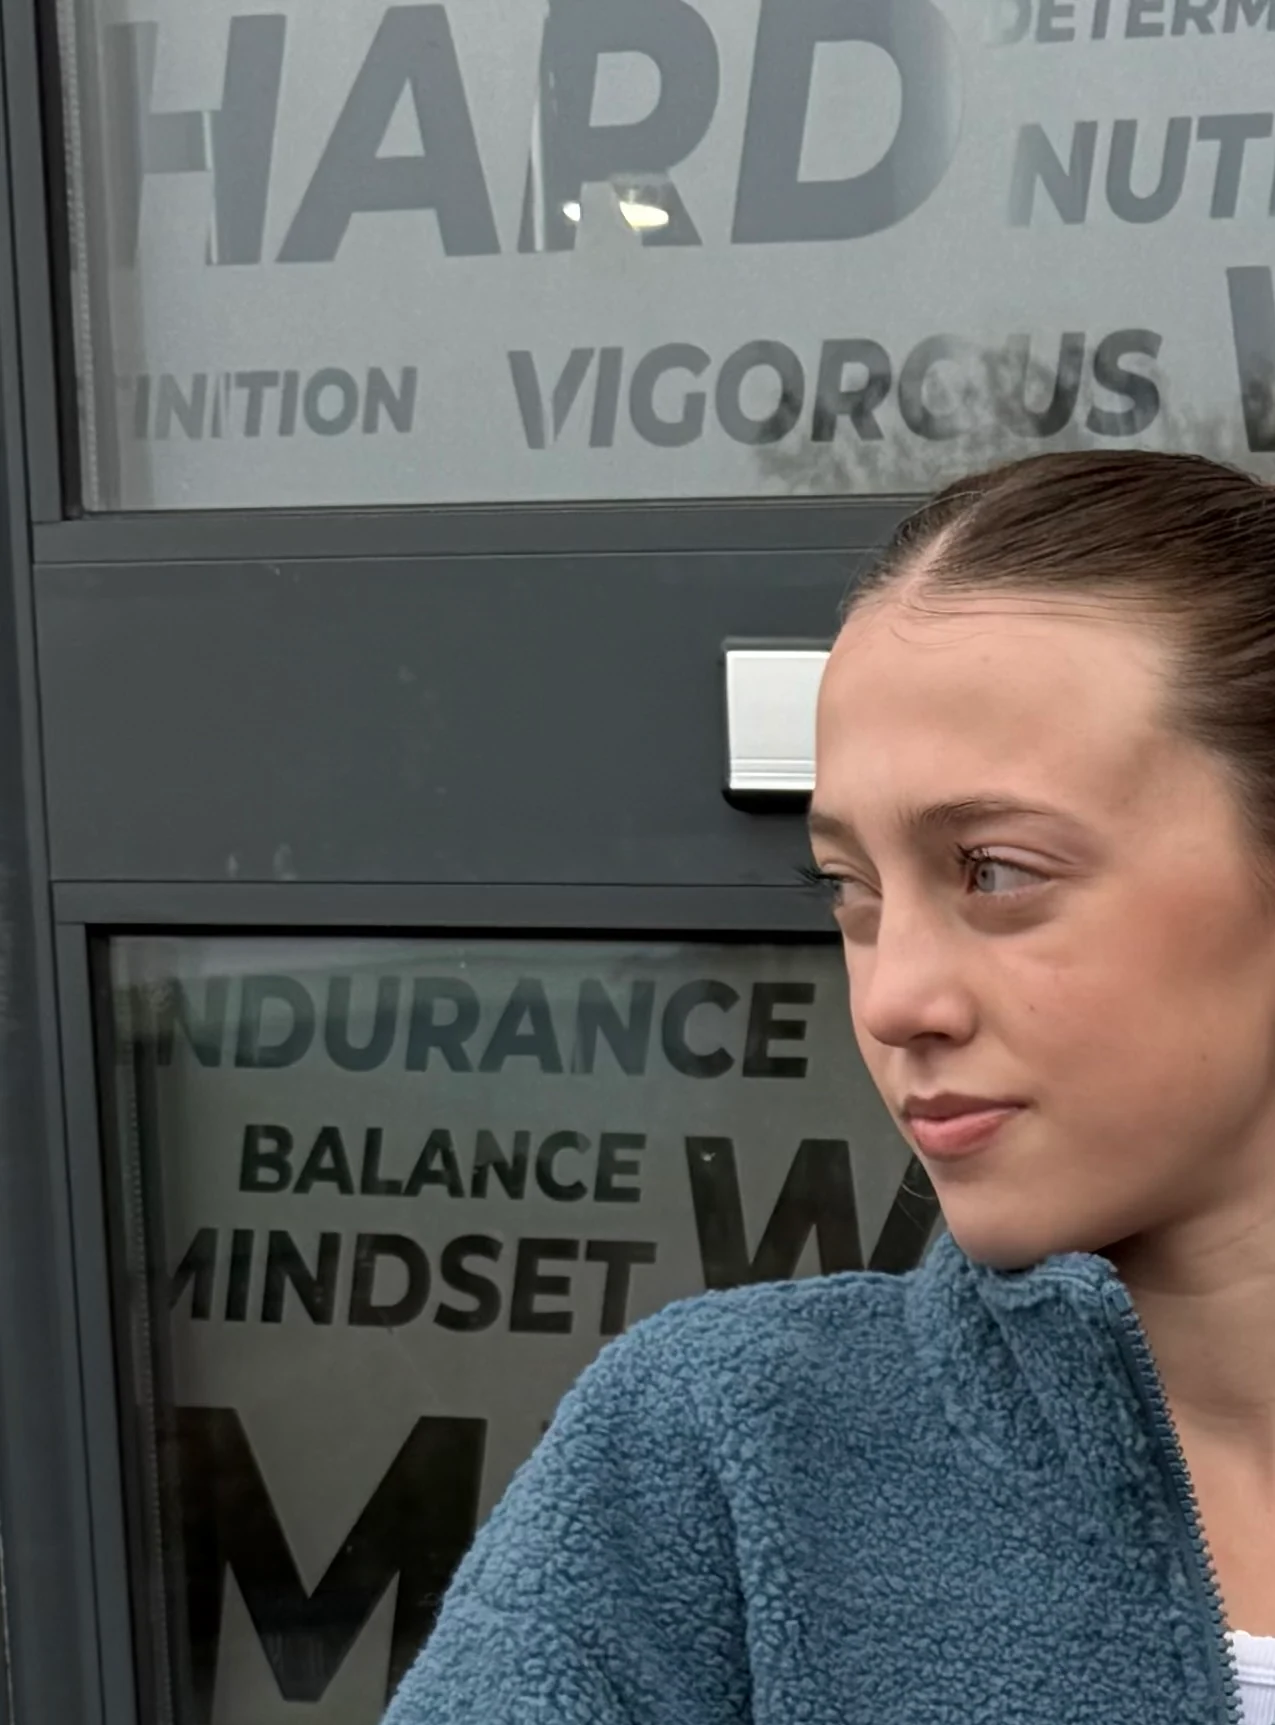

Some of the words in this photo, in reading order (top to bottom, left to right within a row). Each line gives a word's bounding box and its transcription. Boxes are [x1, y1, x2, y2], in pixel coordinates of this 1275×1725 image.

[103, 0, 964, 270] HARD
[118, 366, 418, 441] INITION
[507, 328, 1164, 449] VIGOROUS
[116, 973, 817, 1080] NDURANCE
[239, 1124, 647, 1203] BALANCE
